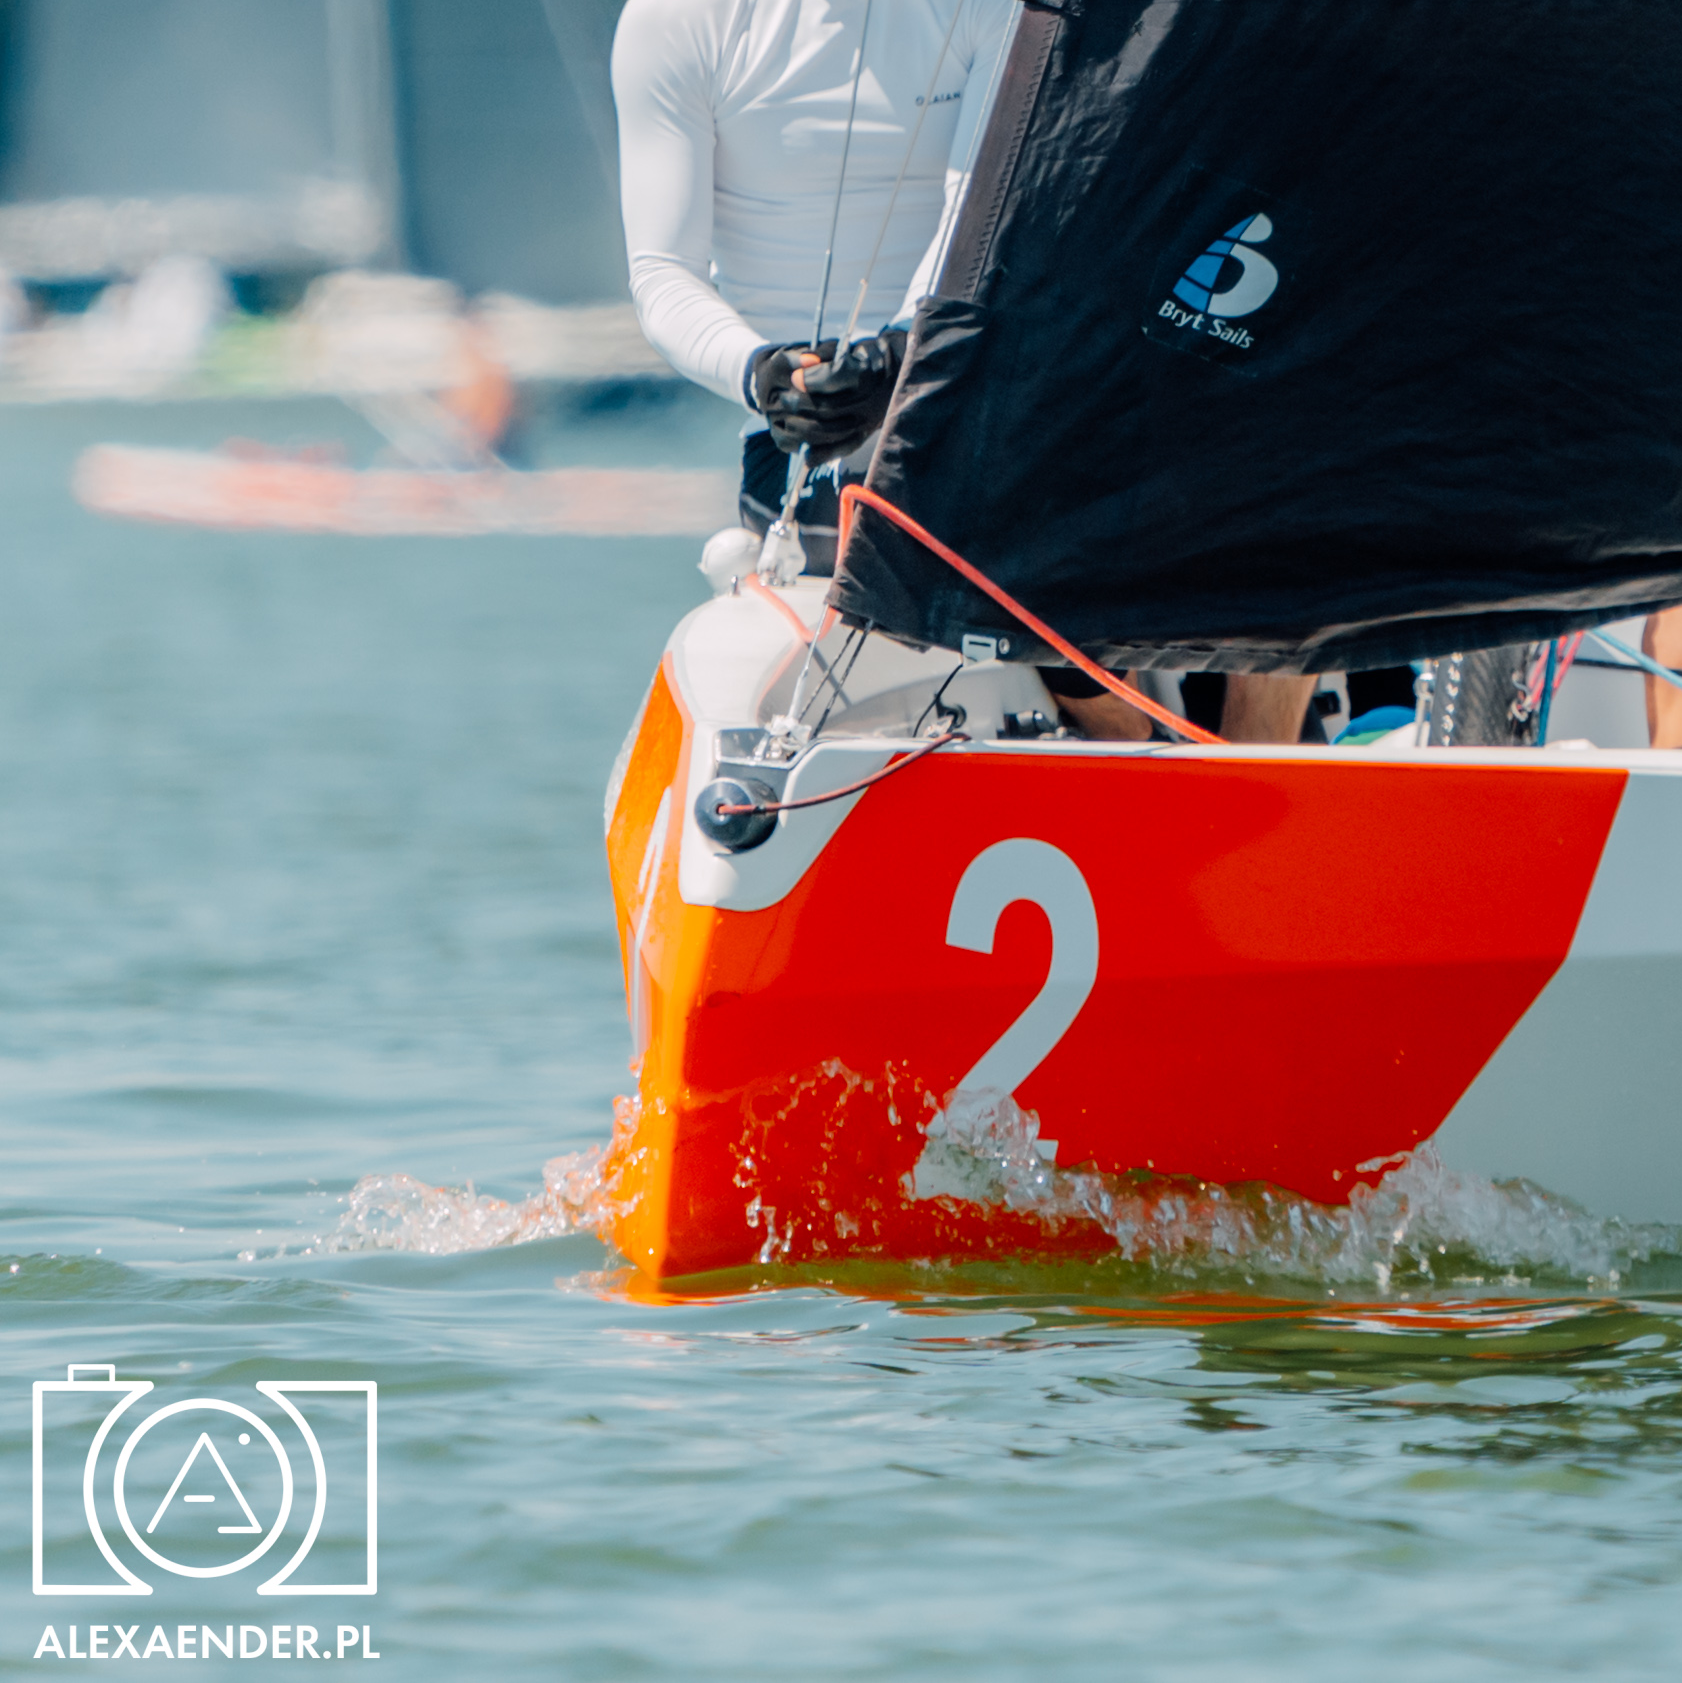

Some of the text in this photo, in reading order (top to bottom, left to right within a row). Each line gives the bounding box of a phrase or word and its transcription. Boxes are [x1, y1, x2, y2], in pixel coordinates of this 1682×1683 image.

[1158, 300, 1254, 349] Bryt Sails
[910, 837, 1099, 1200] 2
